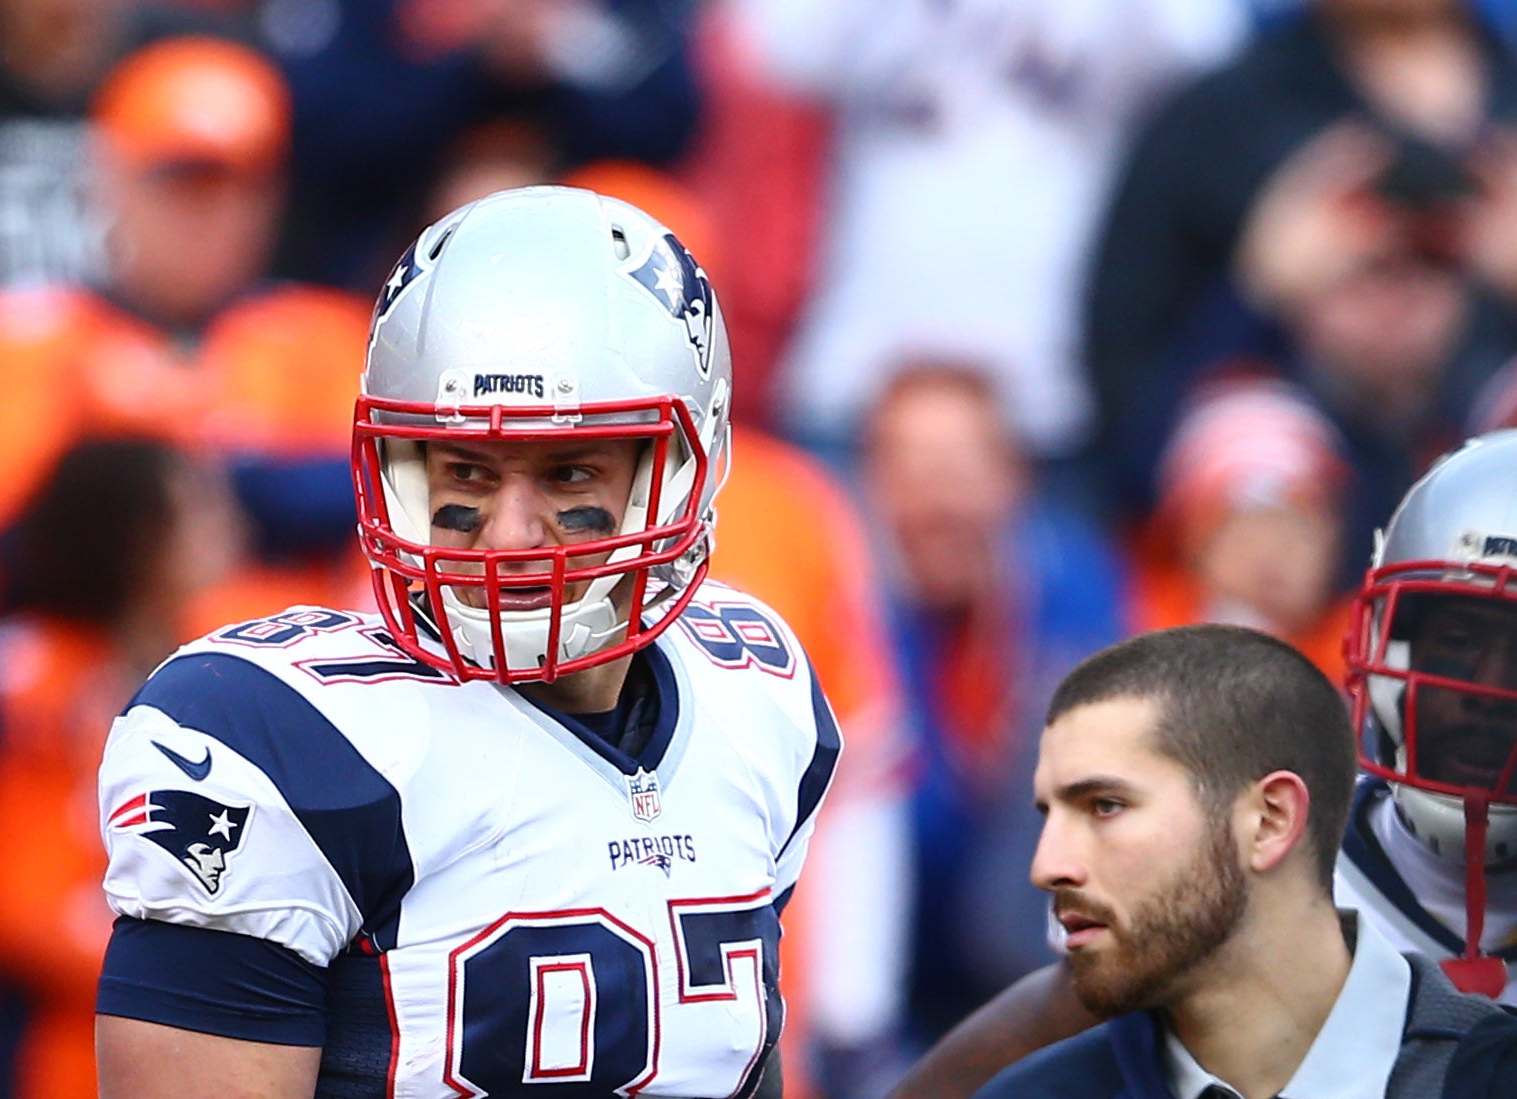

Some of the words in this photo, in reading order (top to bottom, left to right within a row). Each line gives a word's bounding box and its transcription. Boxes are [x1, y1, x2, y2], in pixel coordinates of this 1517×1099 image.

[473, 373, 544, 398] PATRIOTS
[207, 605, 461, 687] 87
[634, 794, 660, 818] NFL
[608, 834, 696, 871] PATRIOTS
